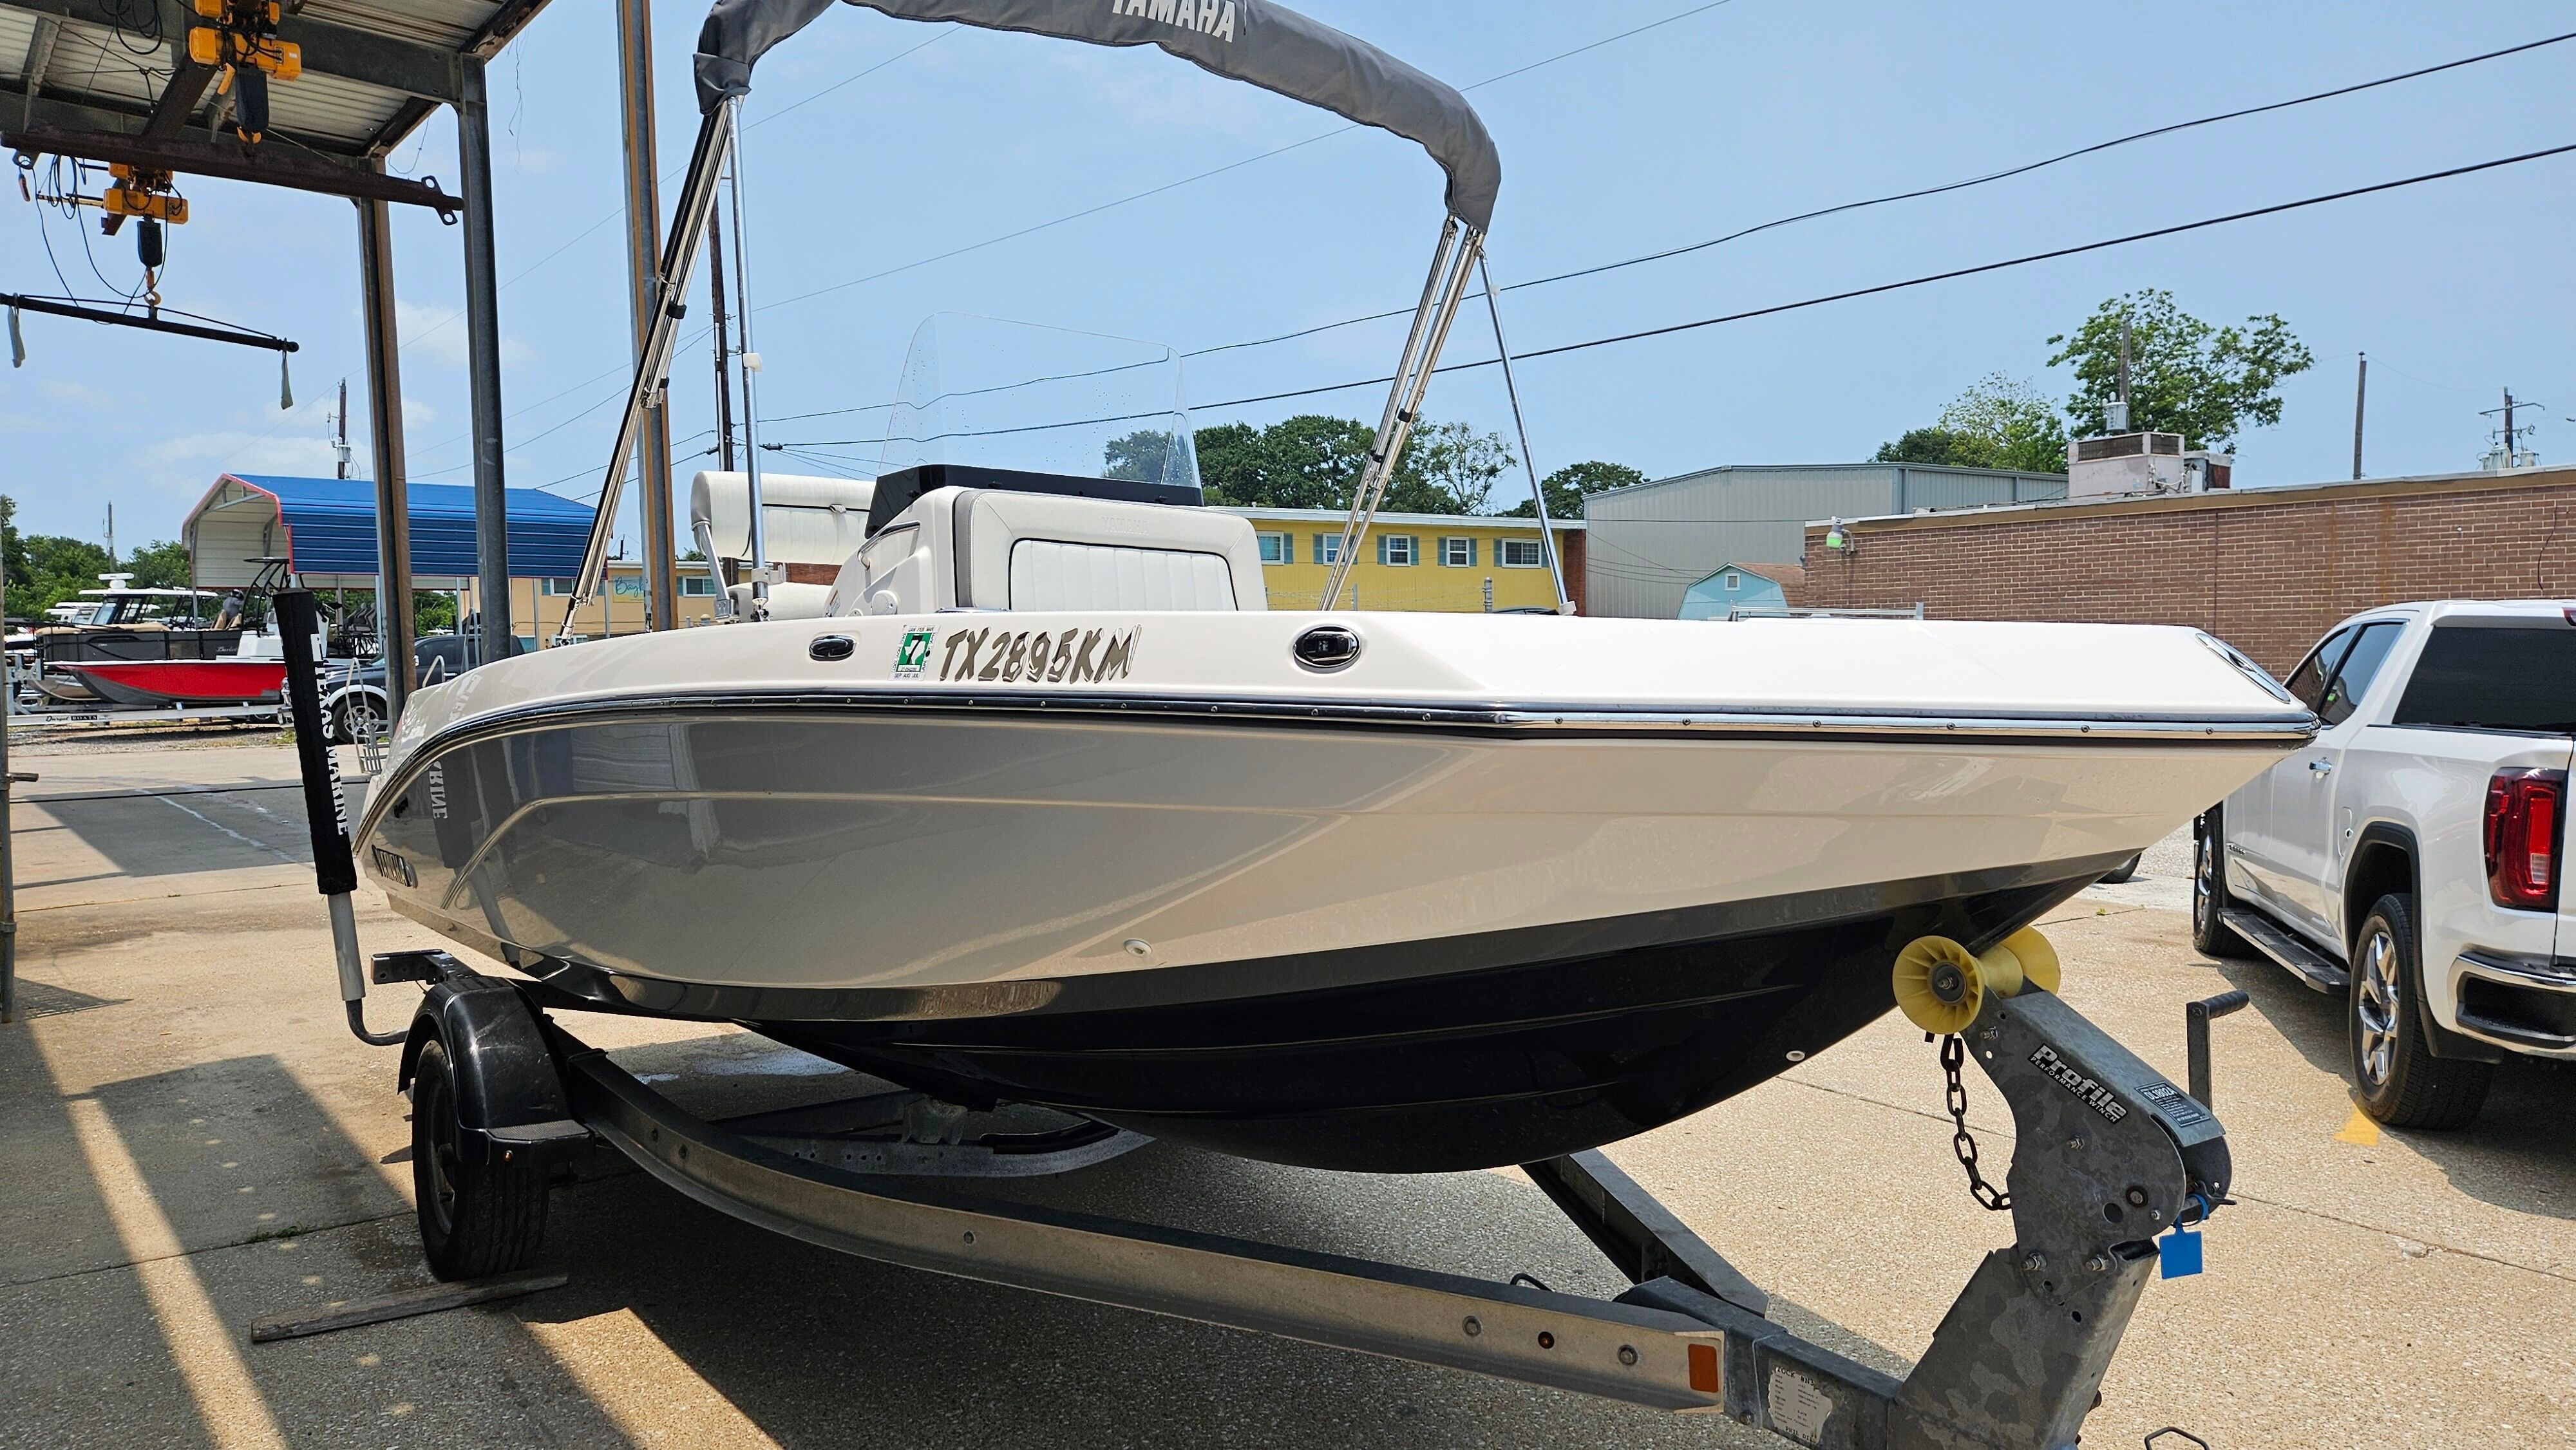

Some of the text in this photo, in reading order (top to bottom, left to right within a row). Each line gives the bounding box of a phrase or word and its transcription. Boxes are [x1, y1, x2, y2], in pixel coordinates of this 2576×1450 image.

[940, 625, 1142, 684] TX2895KM
[2031, 1057, 2088, 1100] PERFORMANCE
[2089, 1100, 2117, 1123] WINCH
[2033, 1044, 2126, 1119] Profile
